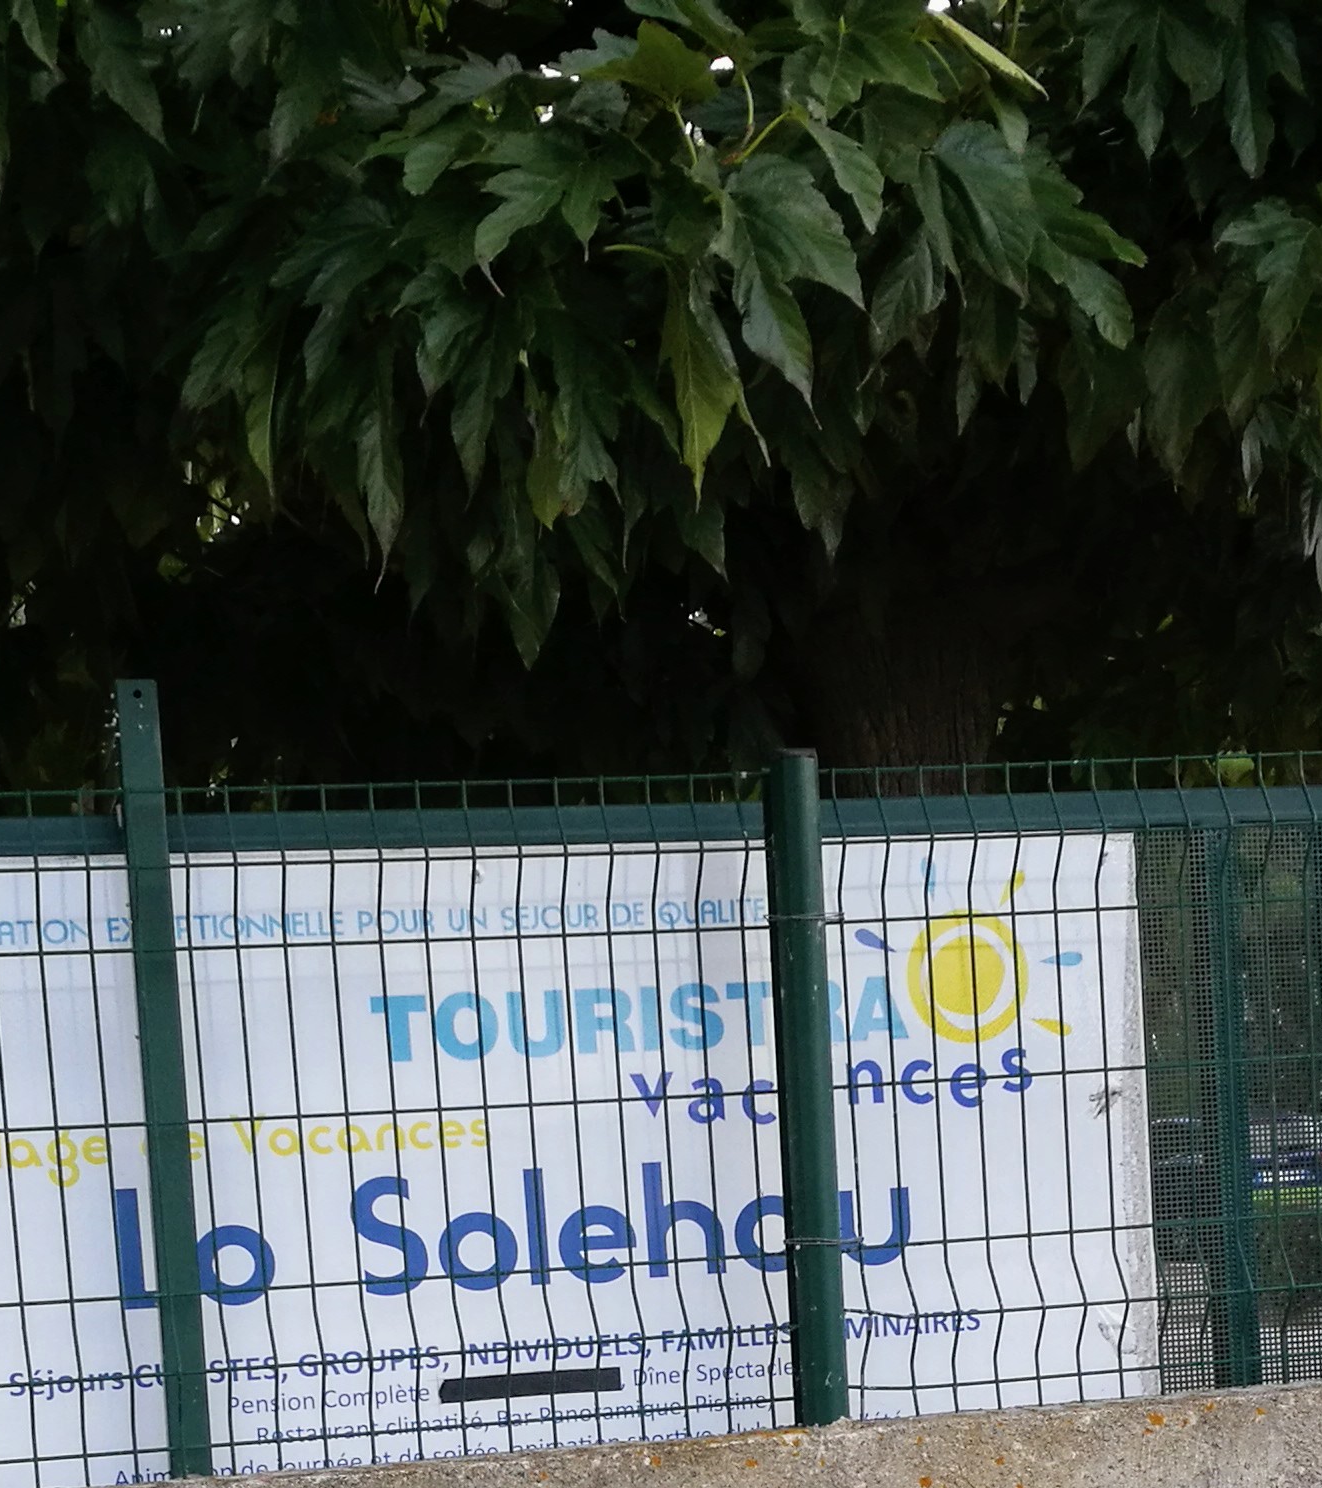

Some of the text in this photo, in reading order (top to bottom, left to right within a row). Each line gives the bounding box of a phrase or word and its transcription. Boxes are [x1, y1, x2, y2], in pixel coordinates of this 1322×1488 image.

[358, 908, 435, 935] POUR
[448, 906, 487, 932] UN
[612, 902, 645, 926] DE
[630, 1047, 1033, 1124] vacnces
[231, 1113, 489, 1158] Vacances
[9, 1369, 125, 1400] Séjours
[461, 1333, 652, 1365] NDIVIDUELS,
[231, 1392, 316, 1414] Pension
[324, 1384, 430, 1410] Complète
